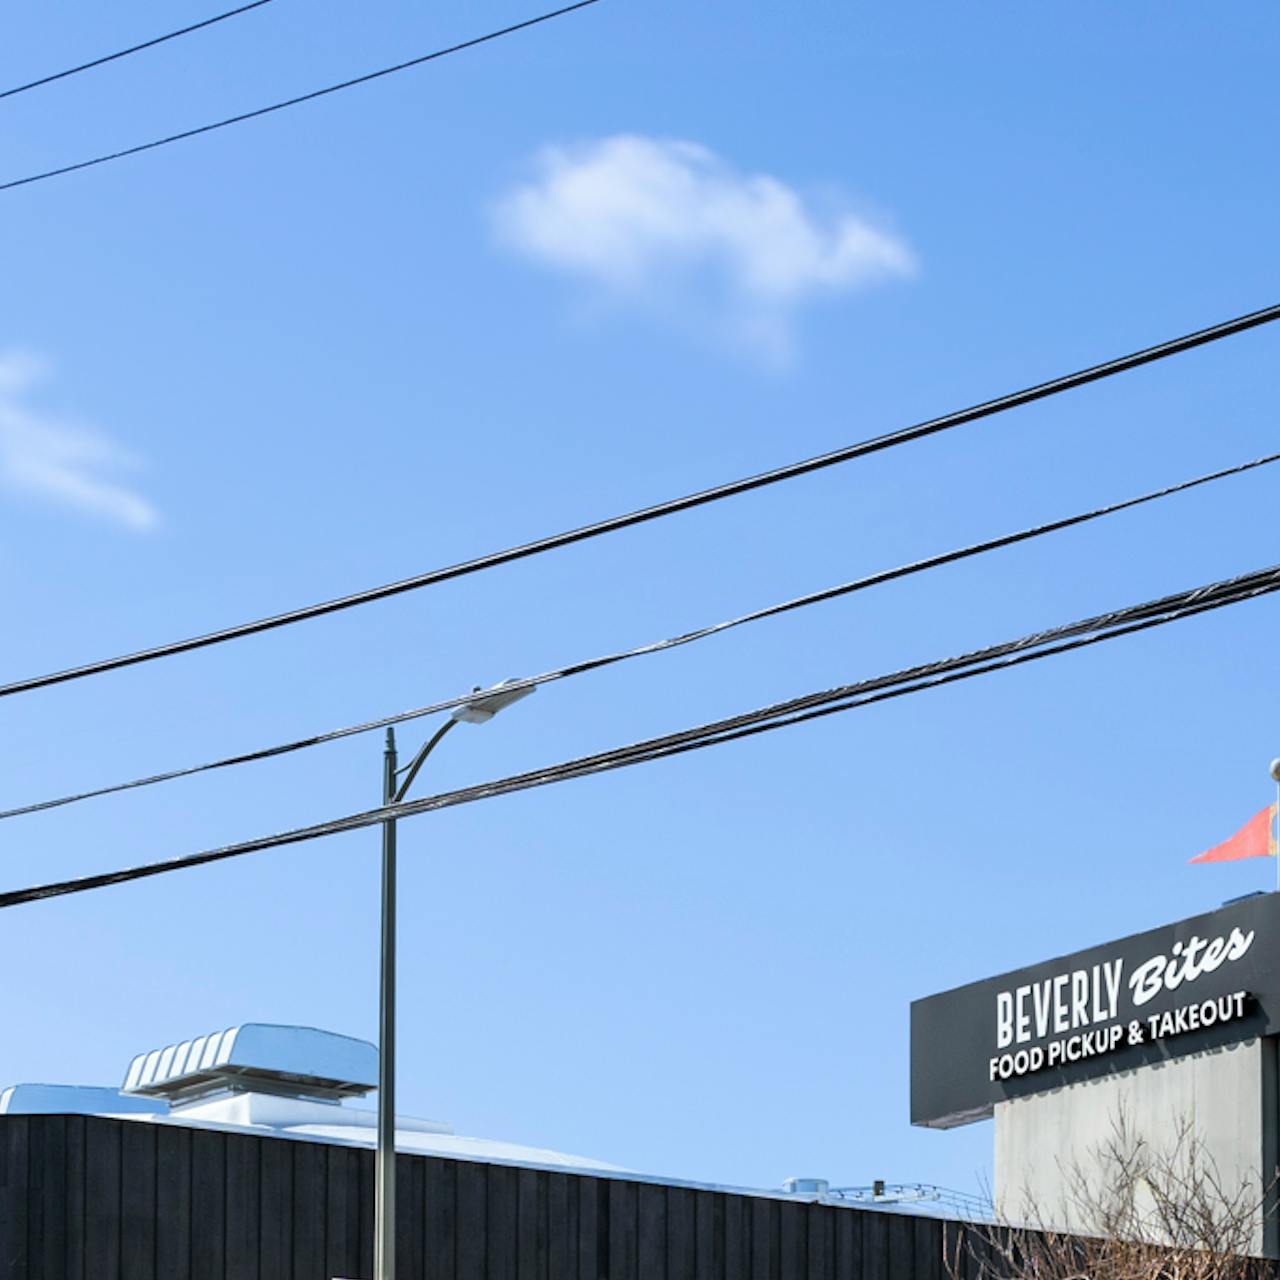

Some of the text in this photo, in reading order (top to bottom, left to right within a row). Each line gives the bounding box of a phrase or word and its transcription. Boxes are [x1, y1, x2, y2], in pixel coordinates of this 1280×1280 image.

[989, 991, 1247, 1081] FOOD PICKUP & TAKEOUT
[996, 927, 1254, 1049] BEVERLY Bites
